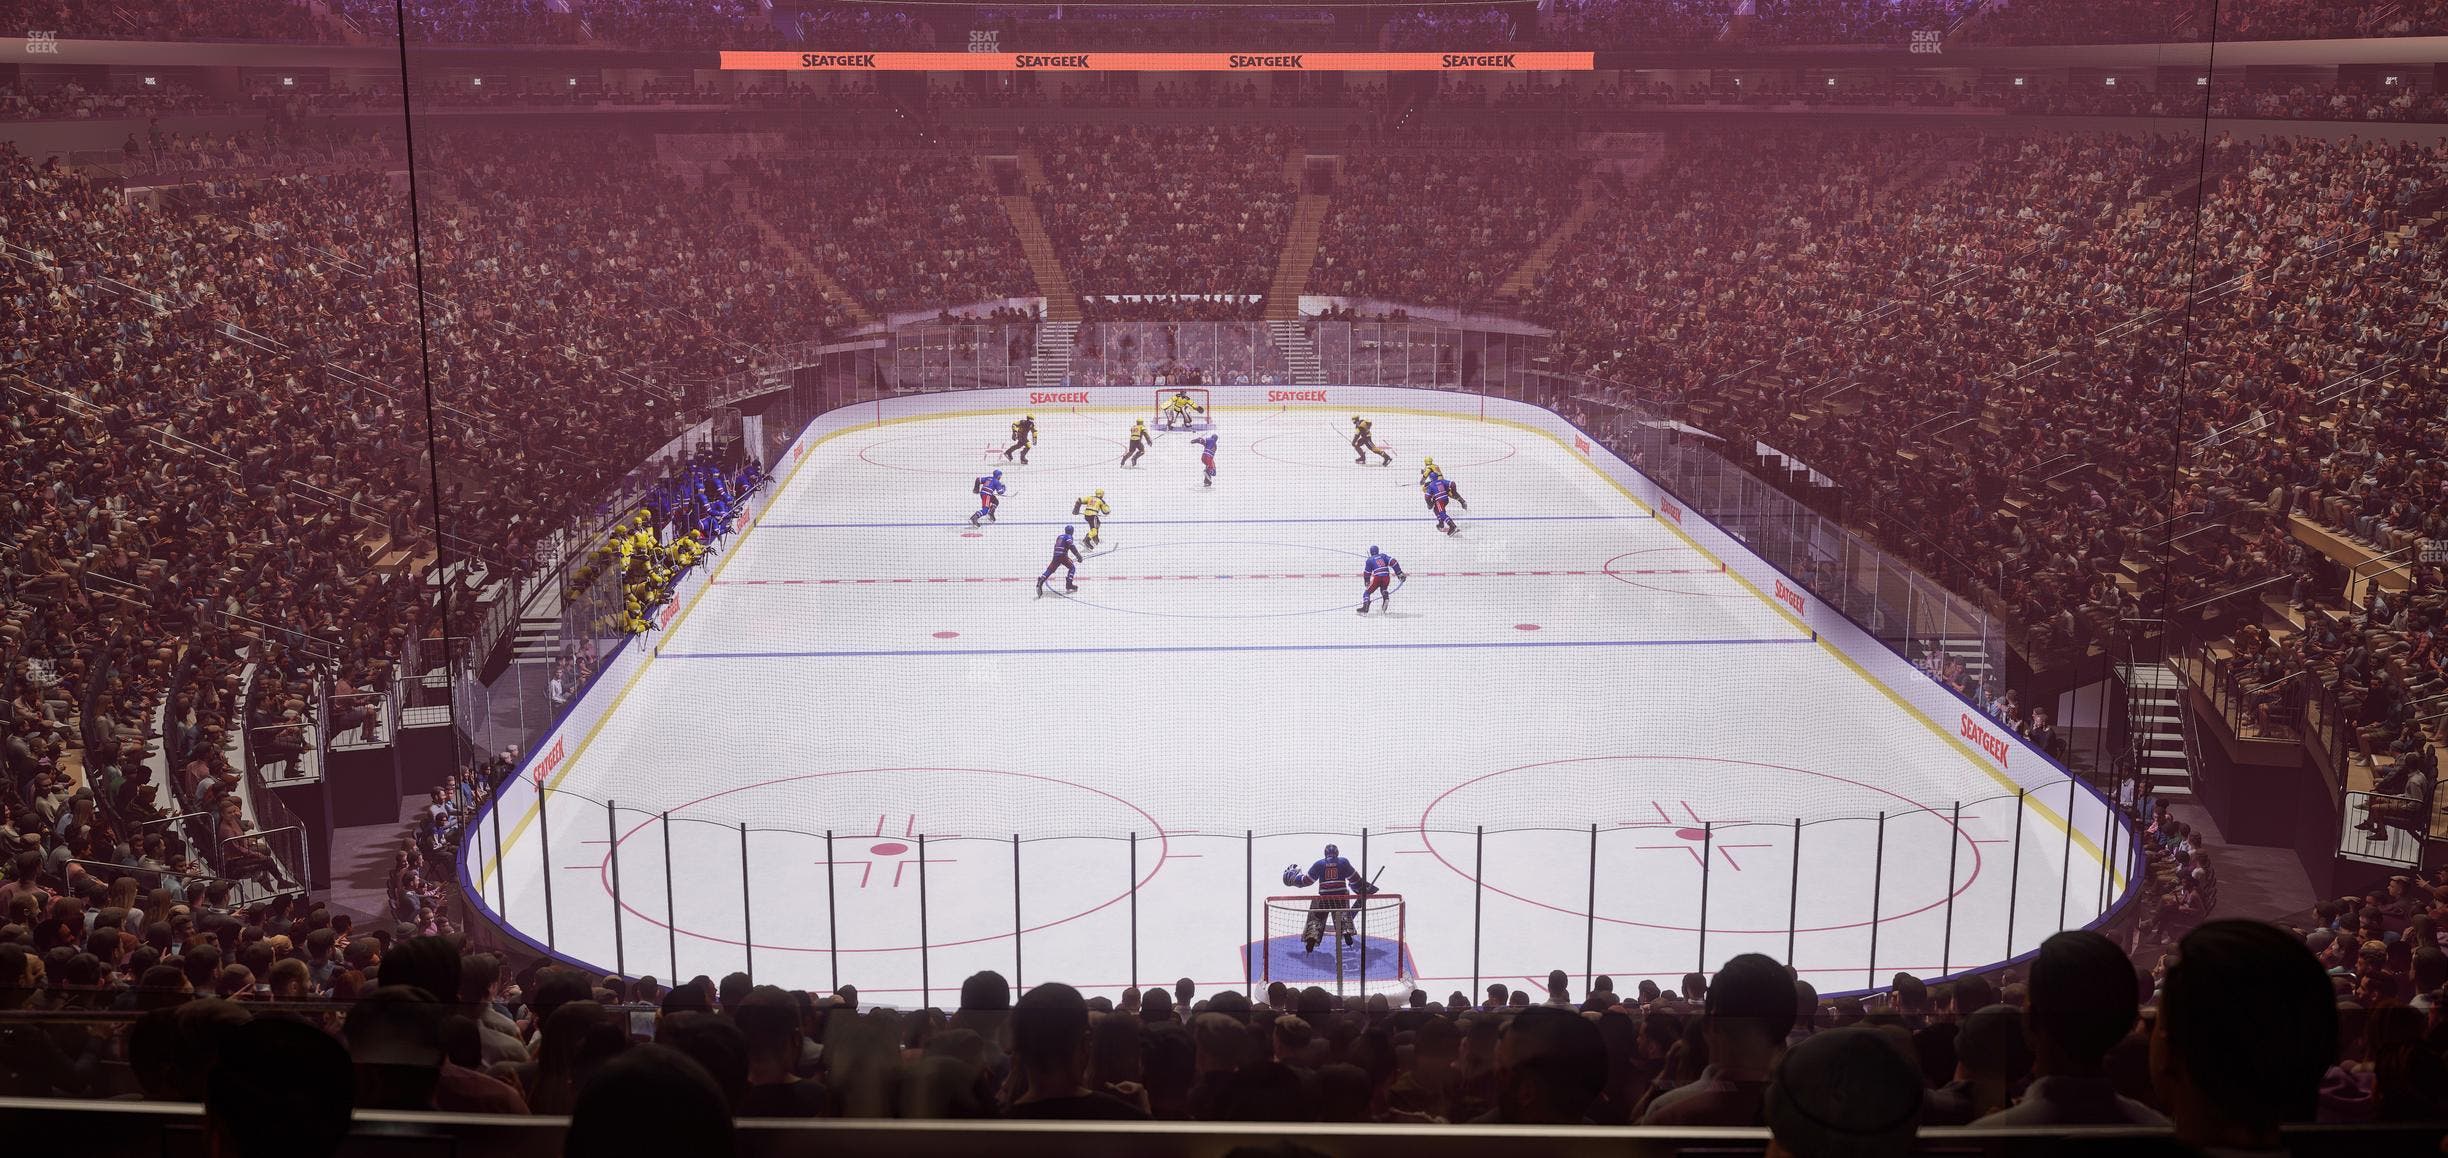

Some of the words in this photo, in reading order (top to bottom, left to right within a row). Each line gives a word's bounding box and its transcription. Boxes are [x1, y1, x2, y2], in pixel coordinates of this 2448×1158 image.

[802, 54, 875, 67] SEATGEEK
[1016, 55, 1089, 68] SEATGEEK
[1230, 55, 1303, 68] SEATGEEK
[1443, 55, 1516, 68] SEATGEEK
[1030, 392, 1089, 404] SEATGEEK
[1268, 390, 1327, 402] SEATGEEK
[1775, 579, 1804, 617] SEATGEEK
[1961, 713, 2008, 769] SEATGEEK
